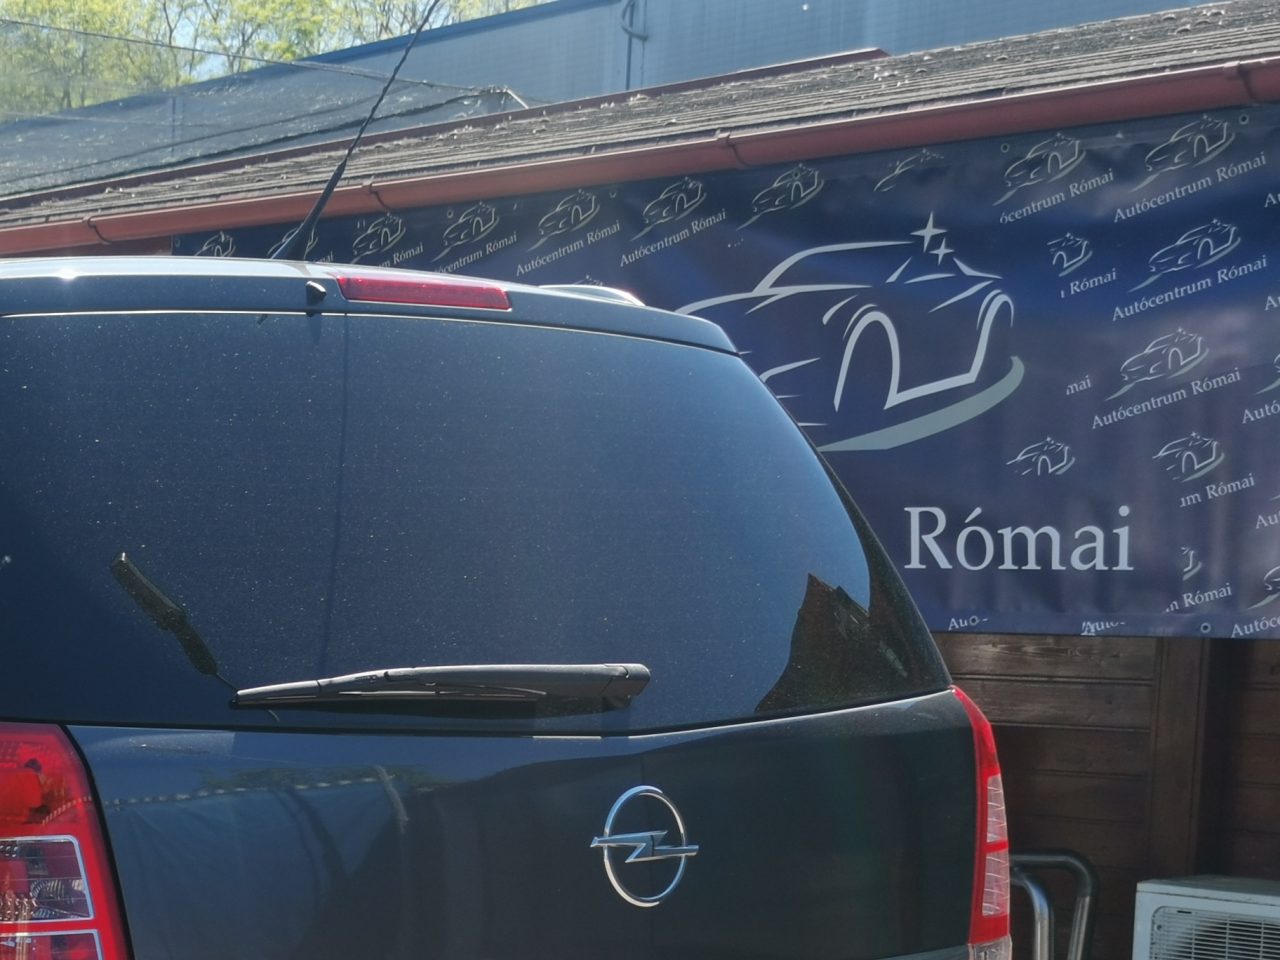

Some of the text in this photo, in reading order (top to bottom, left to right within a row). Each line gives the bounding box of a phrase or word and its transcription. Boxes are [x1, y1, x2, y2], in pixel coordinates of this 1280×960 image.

[1069, 167, 1115, 198] Római
[1113, 152, 1267, 223] Autócentrum Római
[393, 241, 424, 265] Római
[485, 230, 517, 255] Római
[516, 222, 620, 276] Autócentrum Római
[620, 208, 727, 267] Autócentrum Római
[1070, 267, 1117, 296] Római
[1112, 254, 1268, 321] Autócentrum Római
[1092, 367, 1241, 430] Autócentrum Római
[1206, 473, 1255, 500] Római
[904, 505, 1134, 571] Római
[1182, 582, 1232, 608] Római
